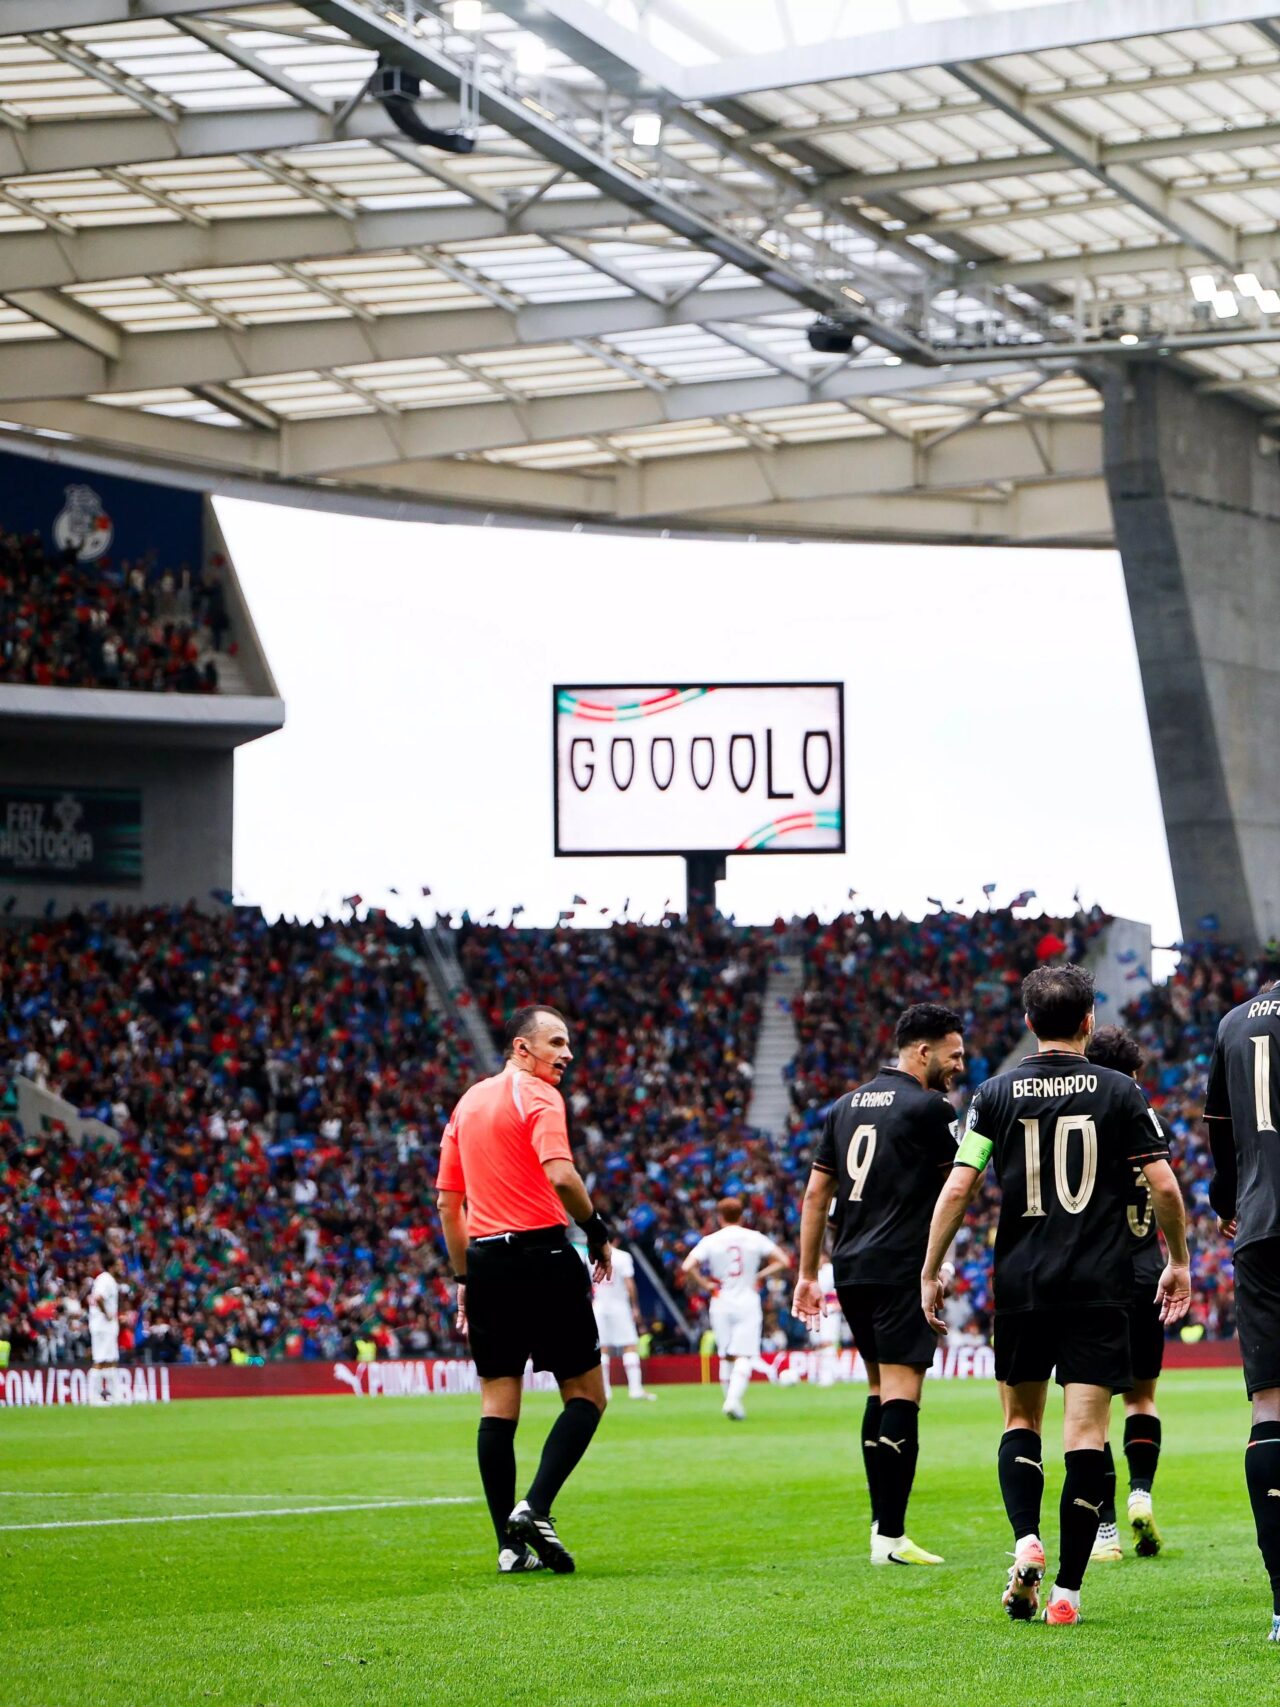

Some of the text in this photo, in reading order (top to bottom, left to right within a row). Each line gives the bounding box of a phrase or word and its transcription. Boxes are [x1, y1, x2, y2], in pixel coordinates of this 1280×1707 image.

[570, 728, 832, 800] GOOOOLO
[1012, 1074, 1098, 1099] BERNARDO
[847, 1124, 877, 1202] 9
[1018, 1114, 1098, 1218] 10
[726, 1246, 744, 1278] 3
